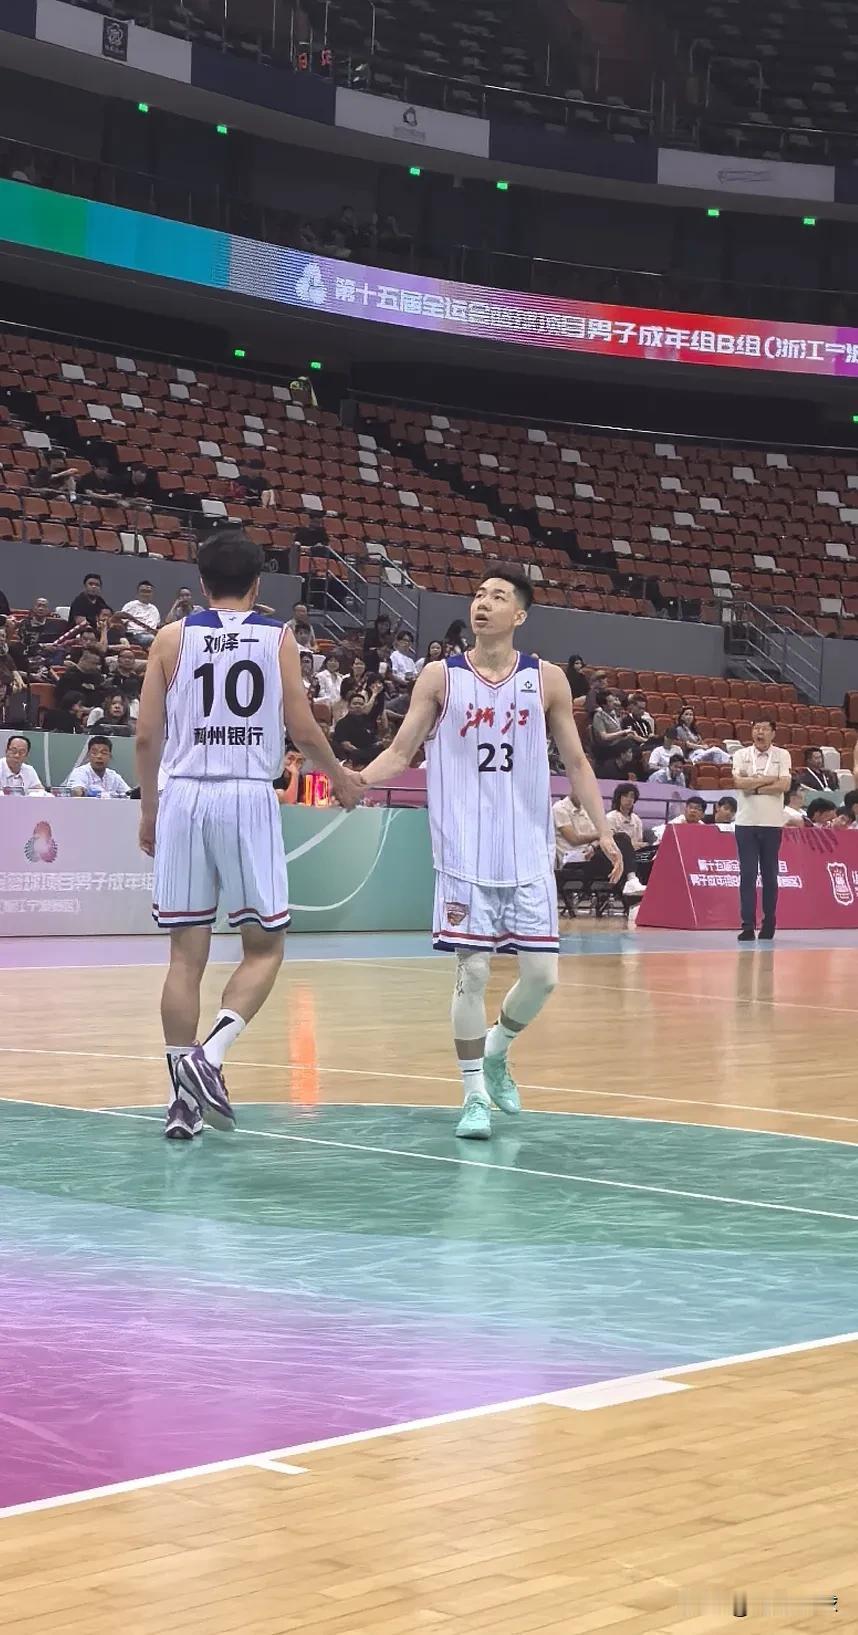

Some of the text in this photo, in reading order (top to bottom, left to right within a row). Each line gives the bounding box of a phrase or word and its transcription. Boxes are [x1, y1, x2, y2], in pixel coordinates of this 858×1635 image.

[203, 632, 259, 653] 刘泽一
[193, 659, 265, 718] 10
[477, 742, 514, 773] 23
